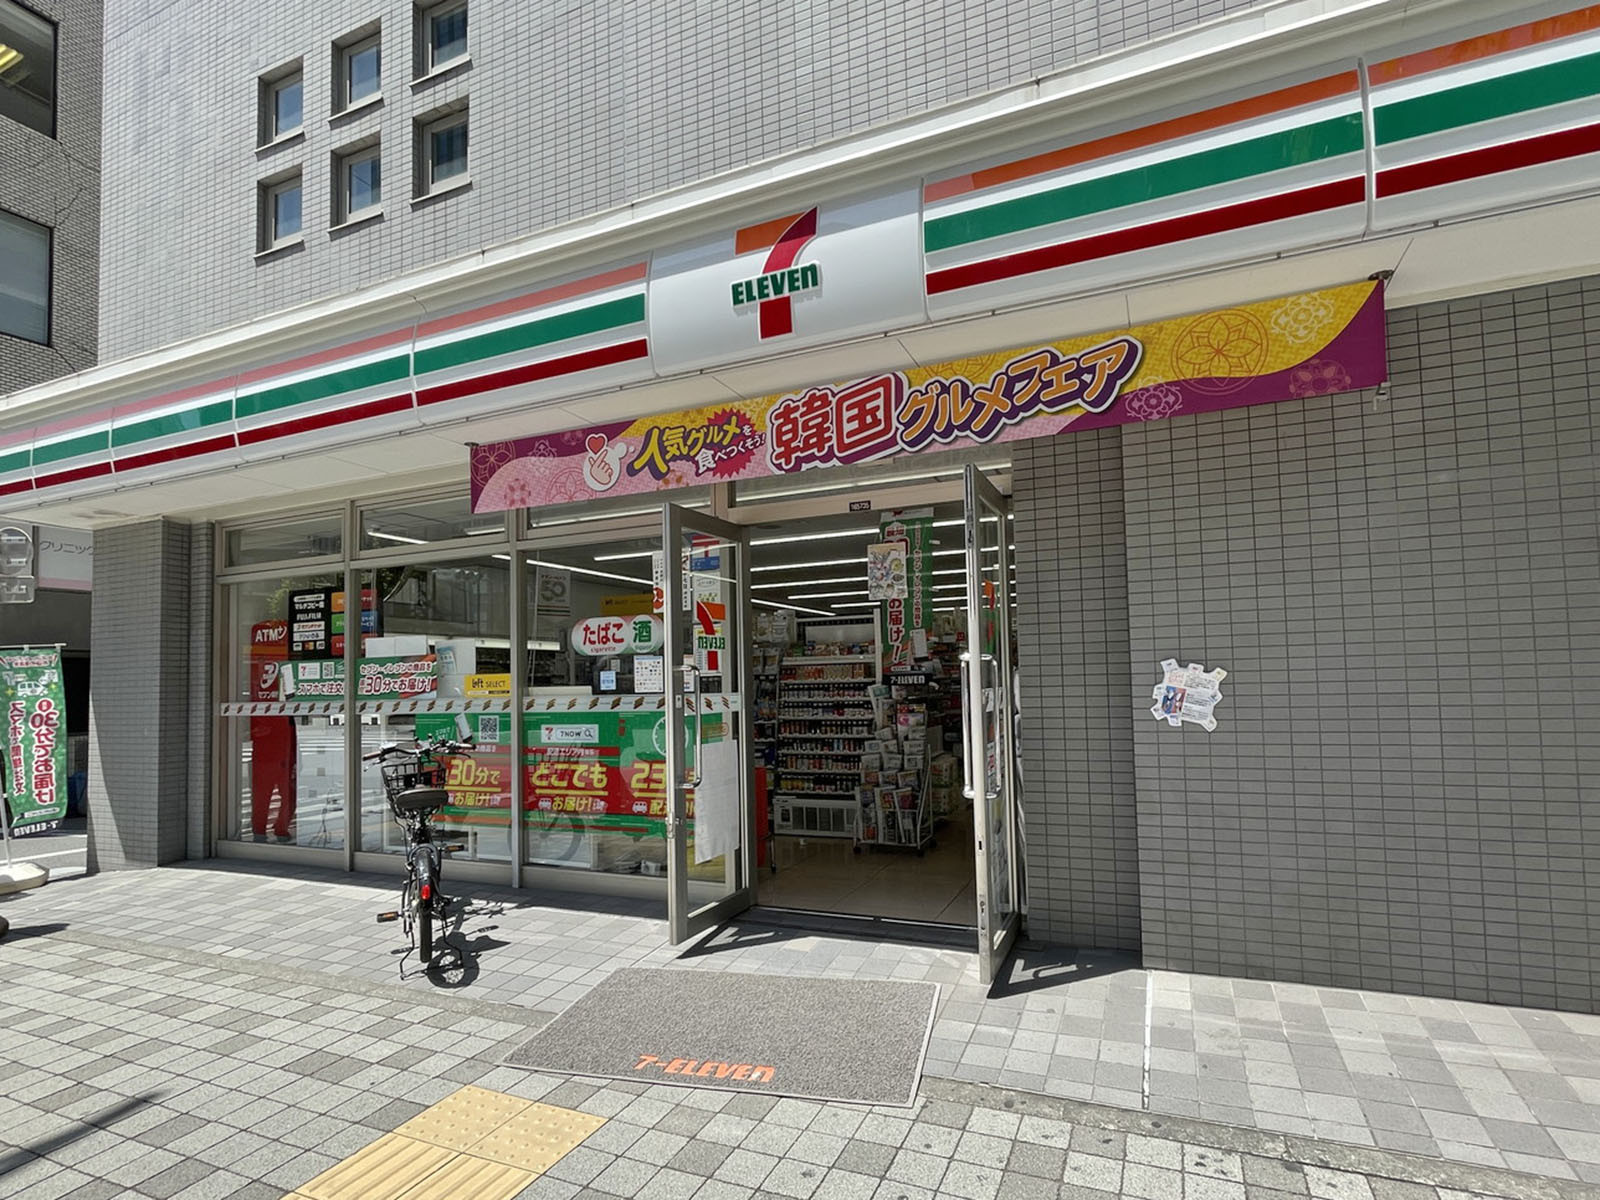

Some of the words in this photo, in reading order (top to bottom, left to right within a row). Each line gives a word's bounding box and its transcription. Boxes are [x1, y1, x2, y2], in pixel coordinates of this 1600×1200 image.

[583, 622, 625, 645] たばこ
[633, 620, 652, 643] 酒
[531, 761, 608, 789] どこでも
[454, 791, 490, 807] お届け!
[552, 796, 593, 812] お届け!
